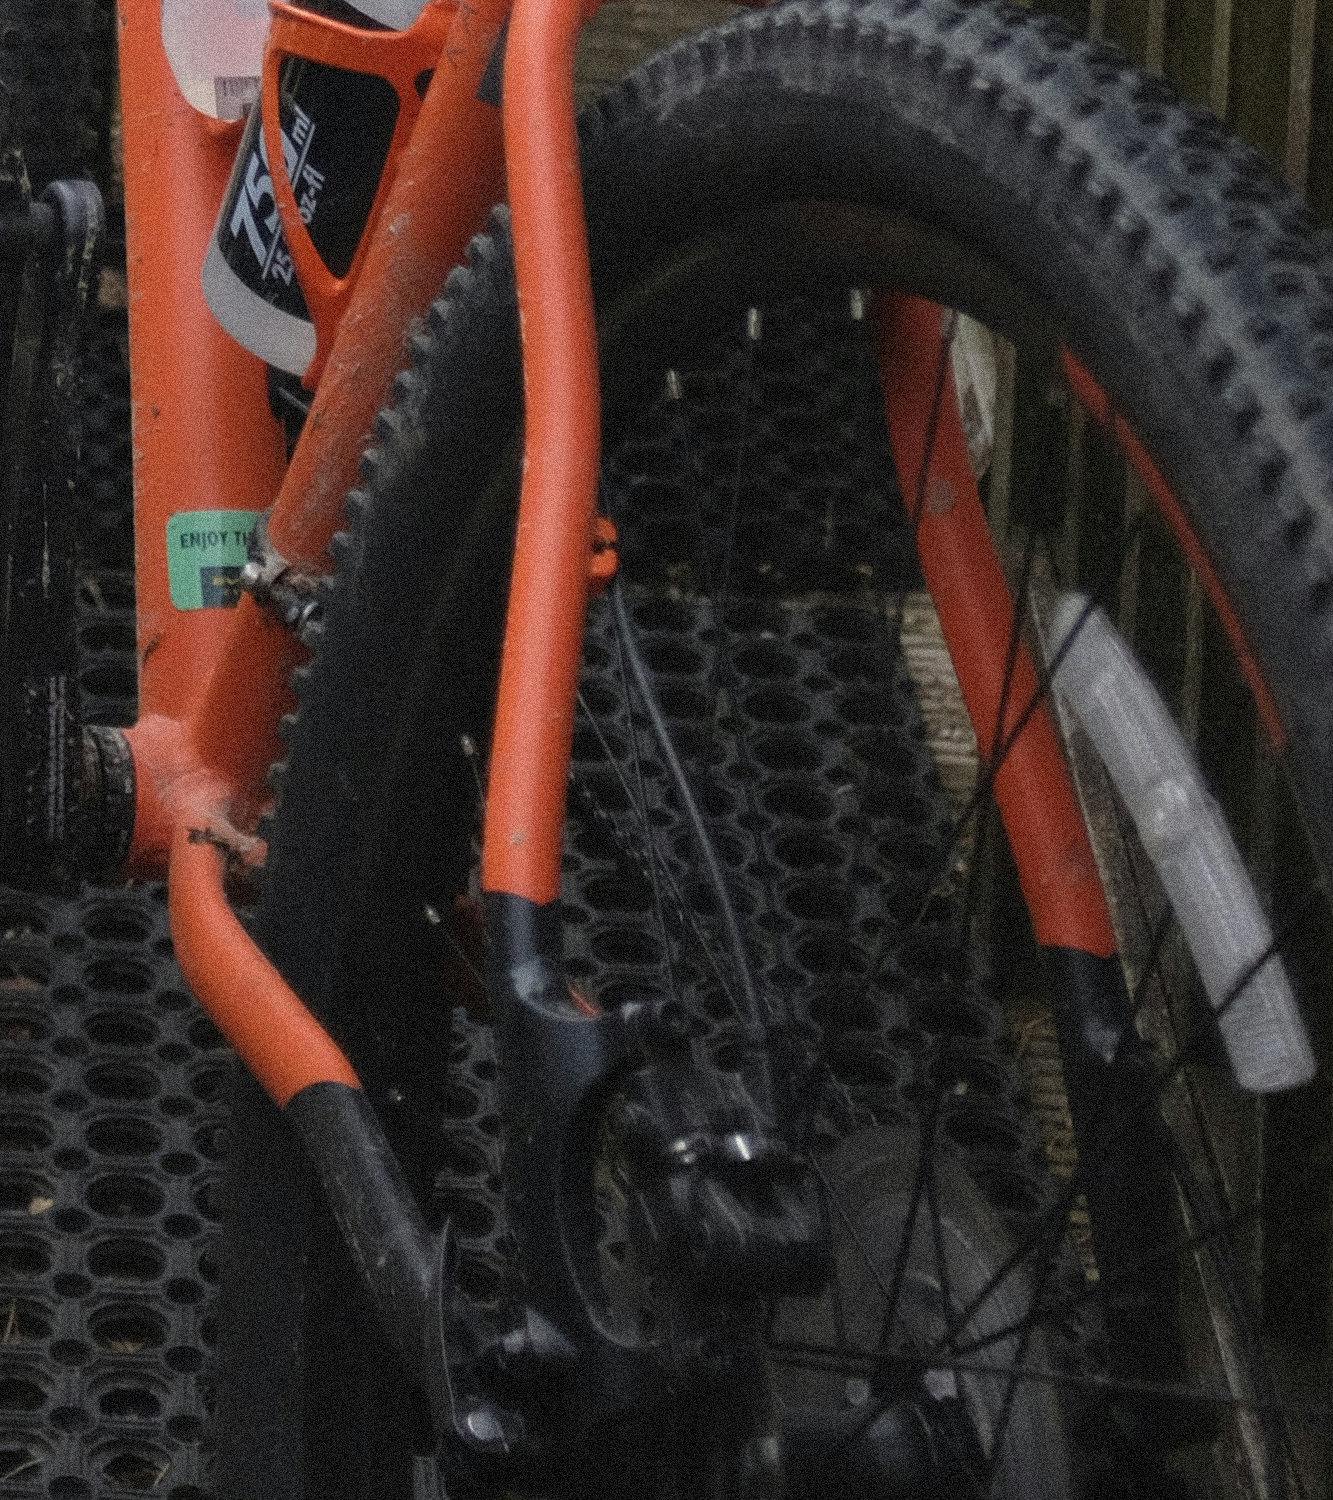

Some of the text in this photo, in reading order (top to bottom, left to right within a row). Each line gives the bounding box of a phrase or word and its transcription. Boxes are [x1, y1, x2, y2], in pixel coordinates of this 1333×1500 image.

[291, 103, 313, 147] ml
[299, 162, 326, 225] oz-fl
[180, 531, 229, 551] ENJOY
